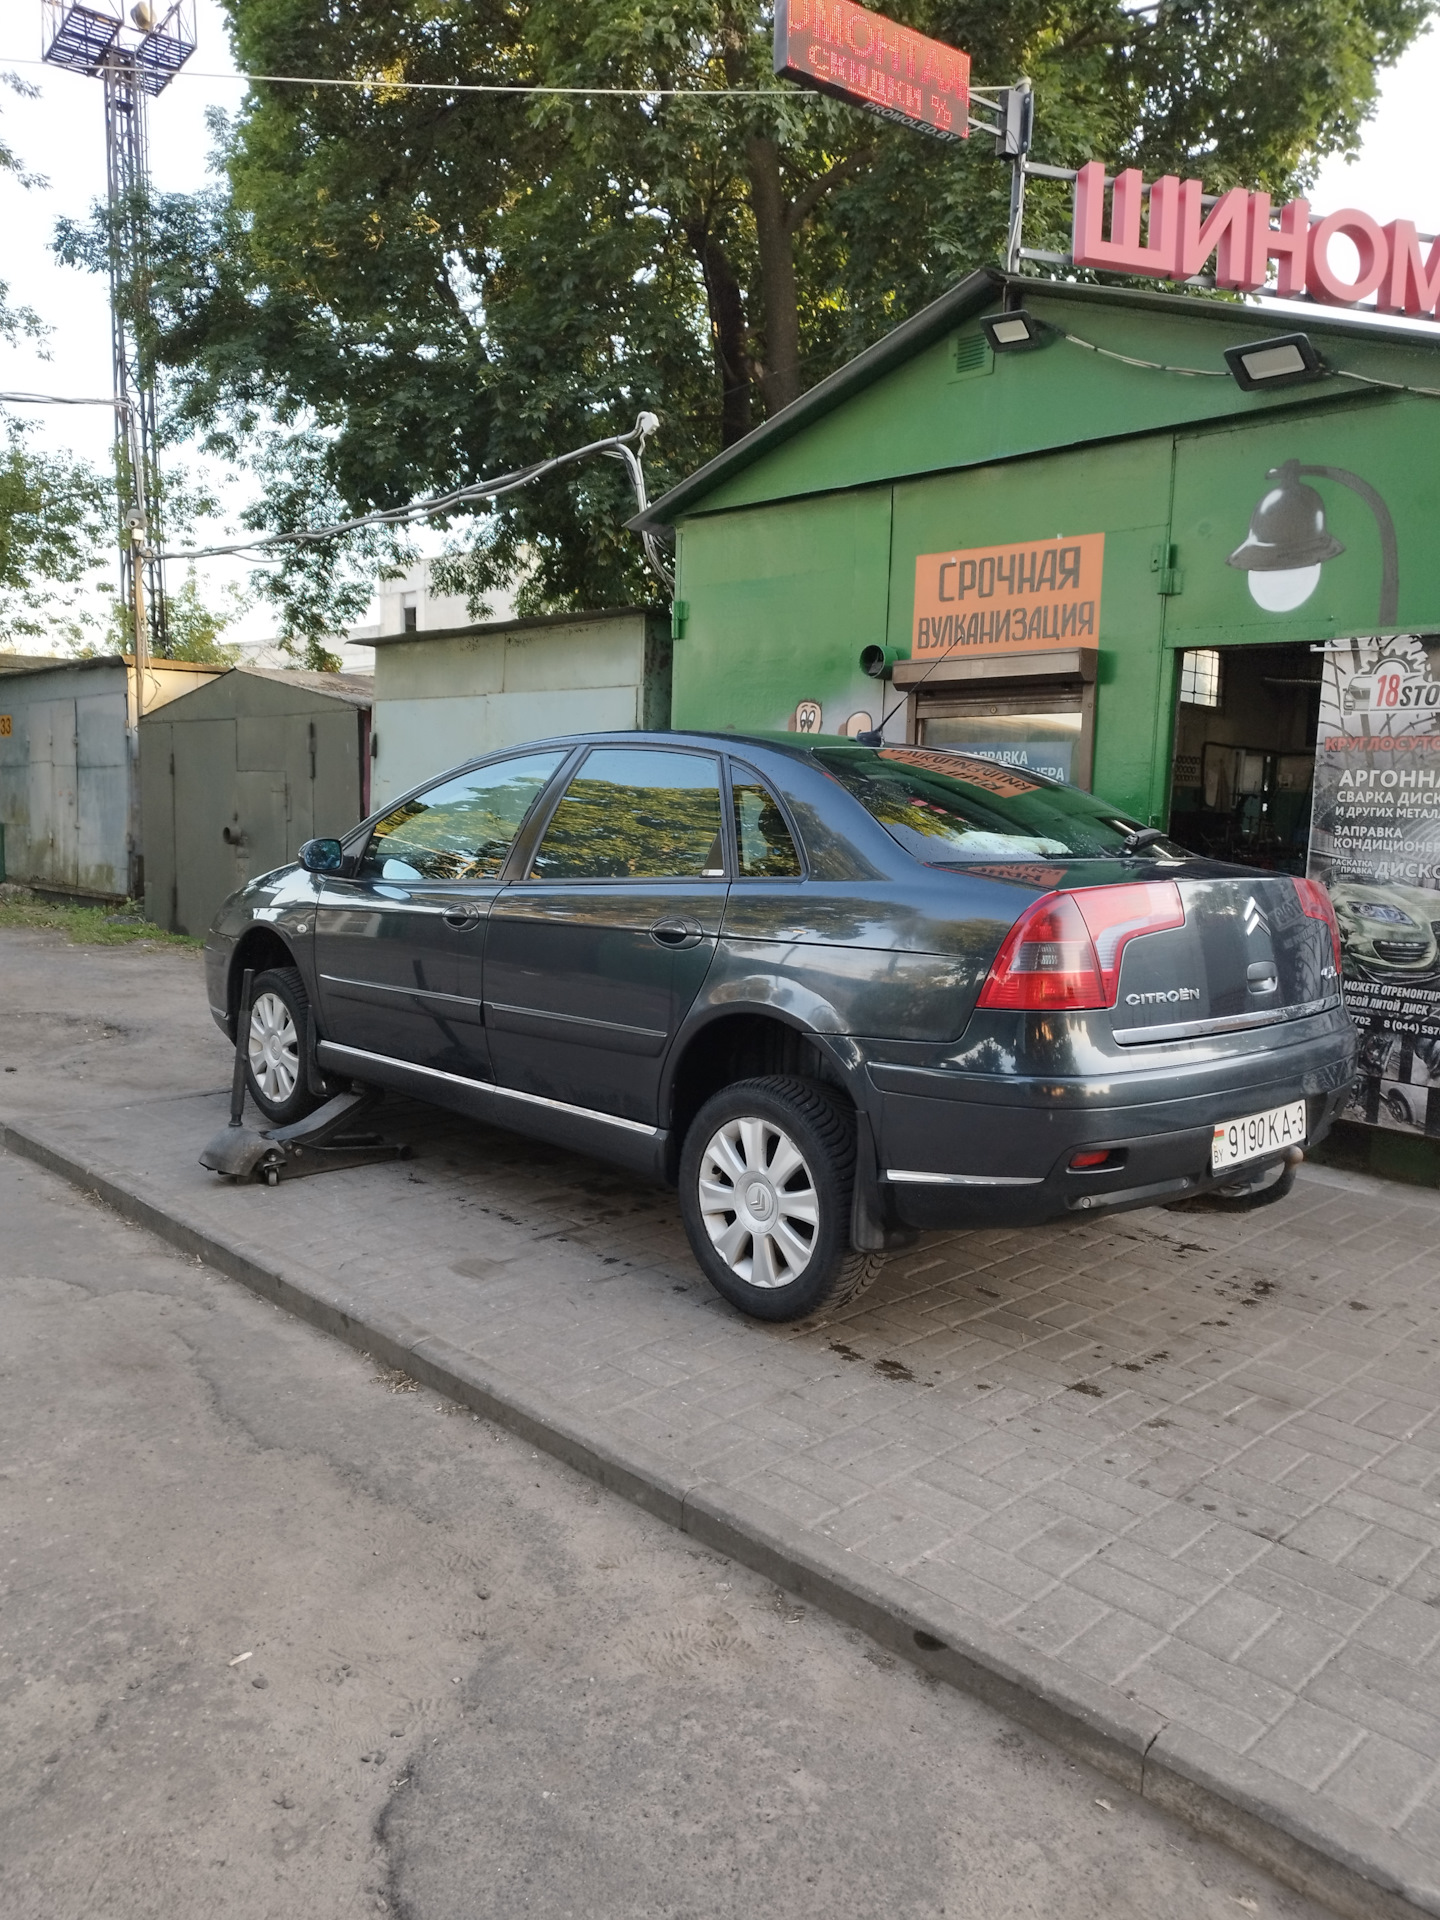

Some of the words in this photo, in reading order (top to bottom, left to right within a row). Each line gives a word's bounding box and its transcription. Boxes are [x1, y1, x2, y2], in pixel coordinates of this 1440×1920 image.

[931, 94, 953, 123] %
[862, 101, 959, 142] PROMOLED.BY
[938, 546, 1081, 602] СРОЧНАЯ
[917, 601, 1095, 649] ВУЛКАНИЗАЦИЯ
[1337, 790, 1394, 803] СВАРКА
[1335, 806, 1344, 816] И
[1346, 806, 1393, 819] ДРУГИХ
[1334, 825, 1403, 838] ЗАПРАВКА
[1331, 858, 1373, 867] РАСКАТКА
[1340, 866, 1373, 875] ПРАВКА
[1343, 980, 1380, 994] МОЖЕТЕ
[1126, 988, 1200, 1006] CITROËN
[1369, 997, 1400, 1012] ЛИТОЙ
[1401, 1002, 1430, 1016] ДИСК
[1383, 1019, 1390, 1028] 8
[1392, 1020, 1420, 1035] (044)
[1421, 1025, 1440, 1036] 587
[1213, 1148, 1224, 1164] BY
